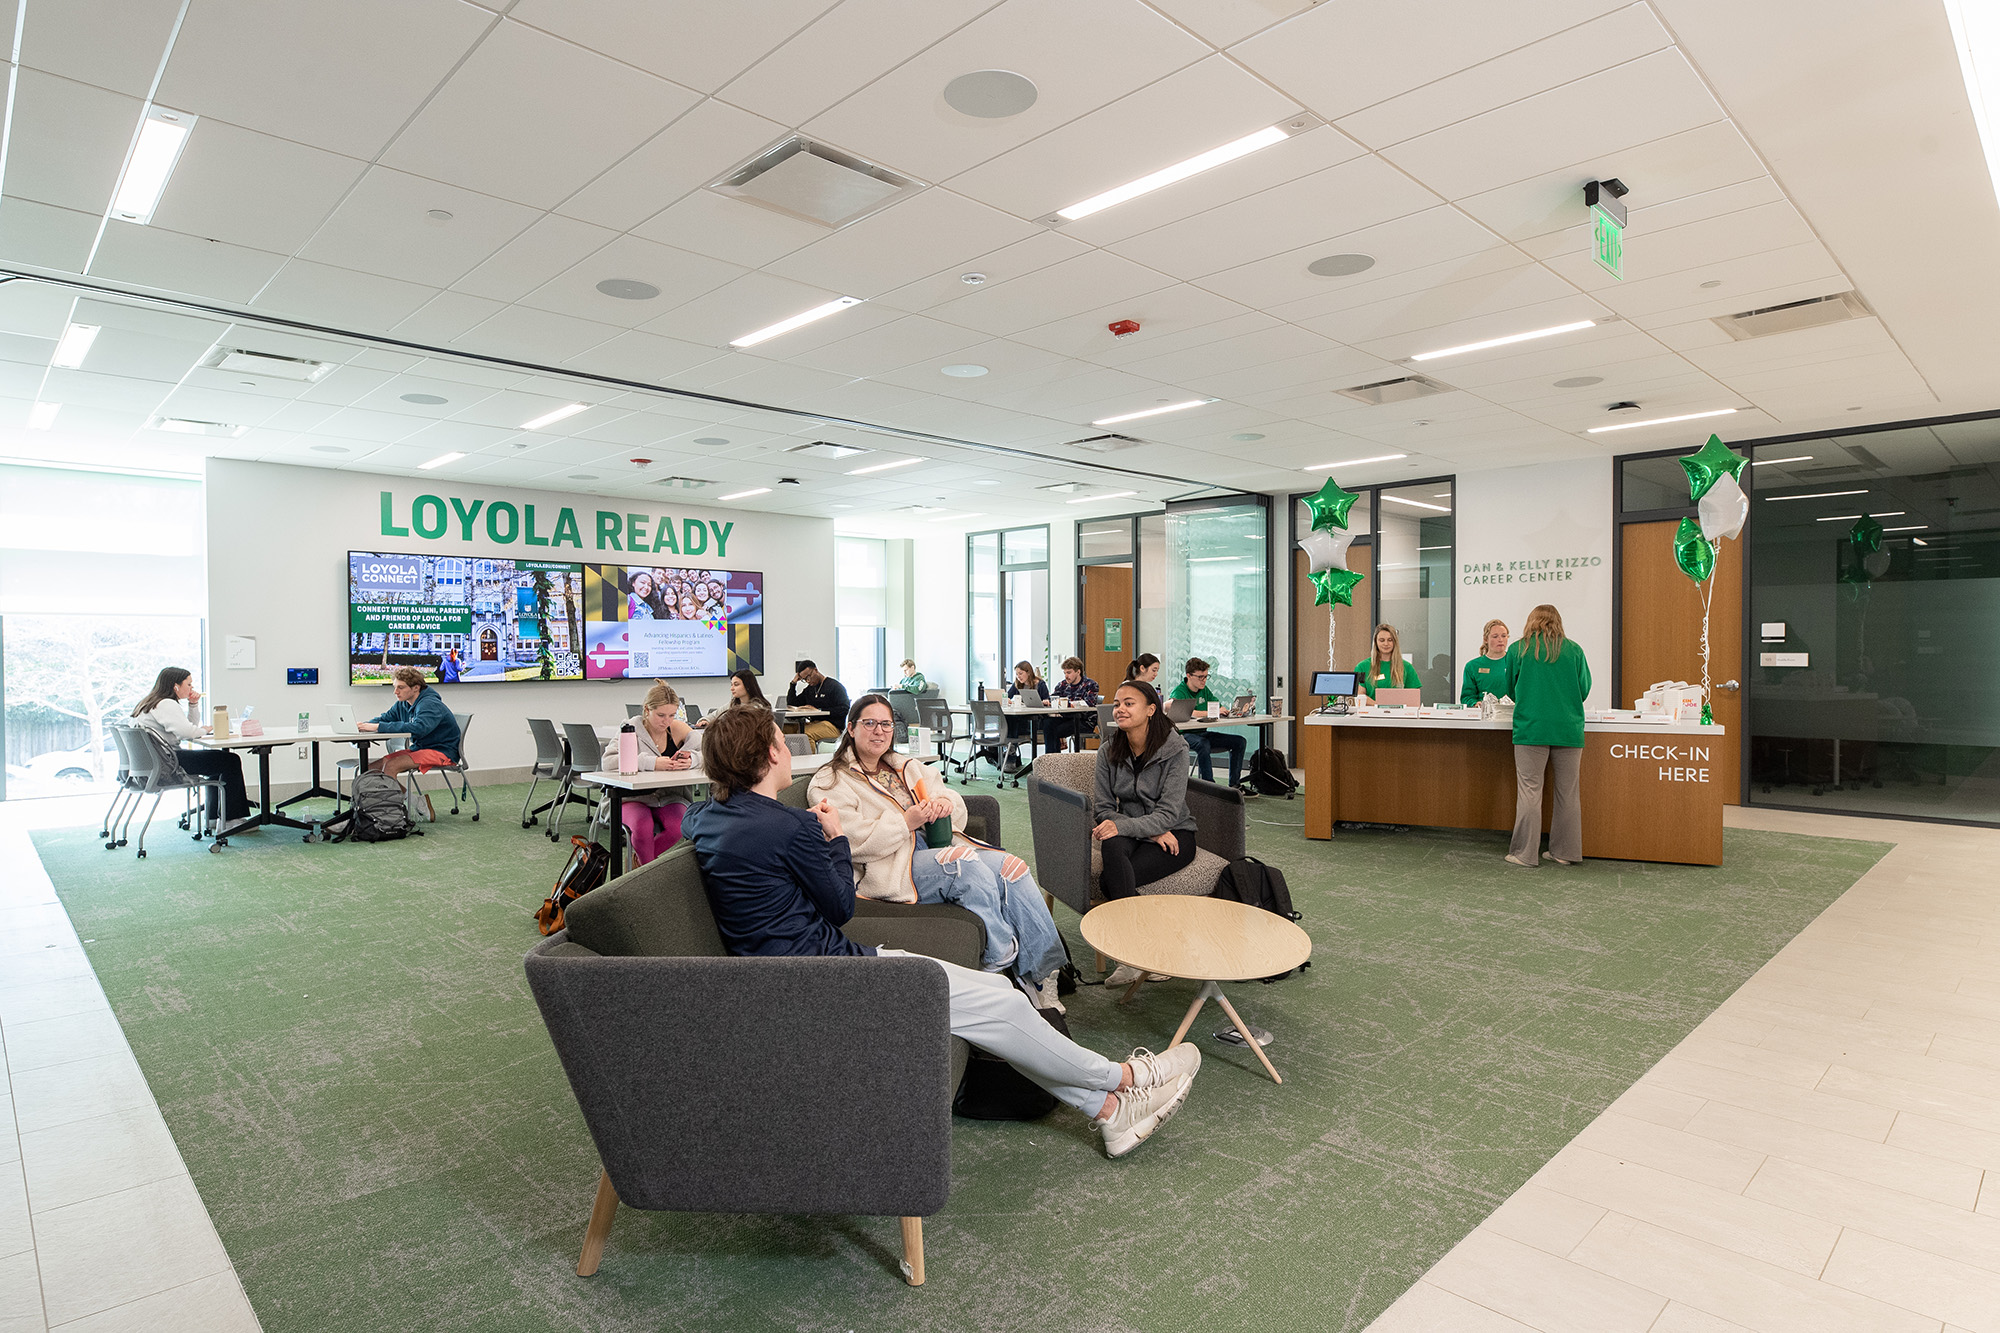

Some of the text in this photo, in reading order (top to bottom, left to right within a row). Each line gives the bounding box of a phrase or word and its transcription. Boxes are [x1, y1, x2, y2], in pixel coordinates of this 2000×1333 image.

[1599, 215, 1618, 271] EXIT
[380, 491, 734, 557] LOYOLA READY
[362, 563, 418, 575] LOYOLA
[525, 562, 571, 570] LOYOLA.EDU/CONNECT
[1464, 556, 1602, 573] DAN & KELLY RIZZO
[361, 574, 418, 584] CONNECT
[1463, 571, 1573, 585] CAREER CENTER
[381, 614, 411, 622] FRIENDS
[439, 607, 469, 615] PARENTS
[1609, 744, 1710, 762] CHECK-IN
[1658, 766, 1710, 783] HERE
